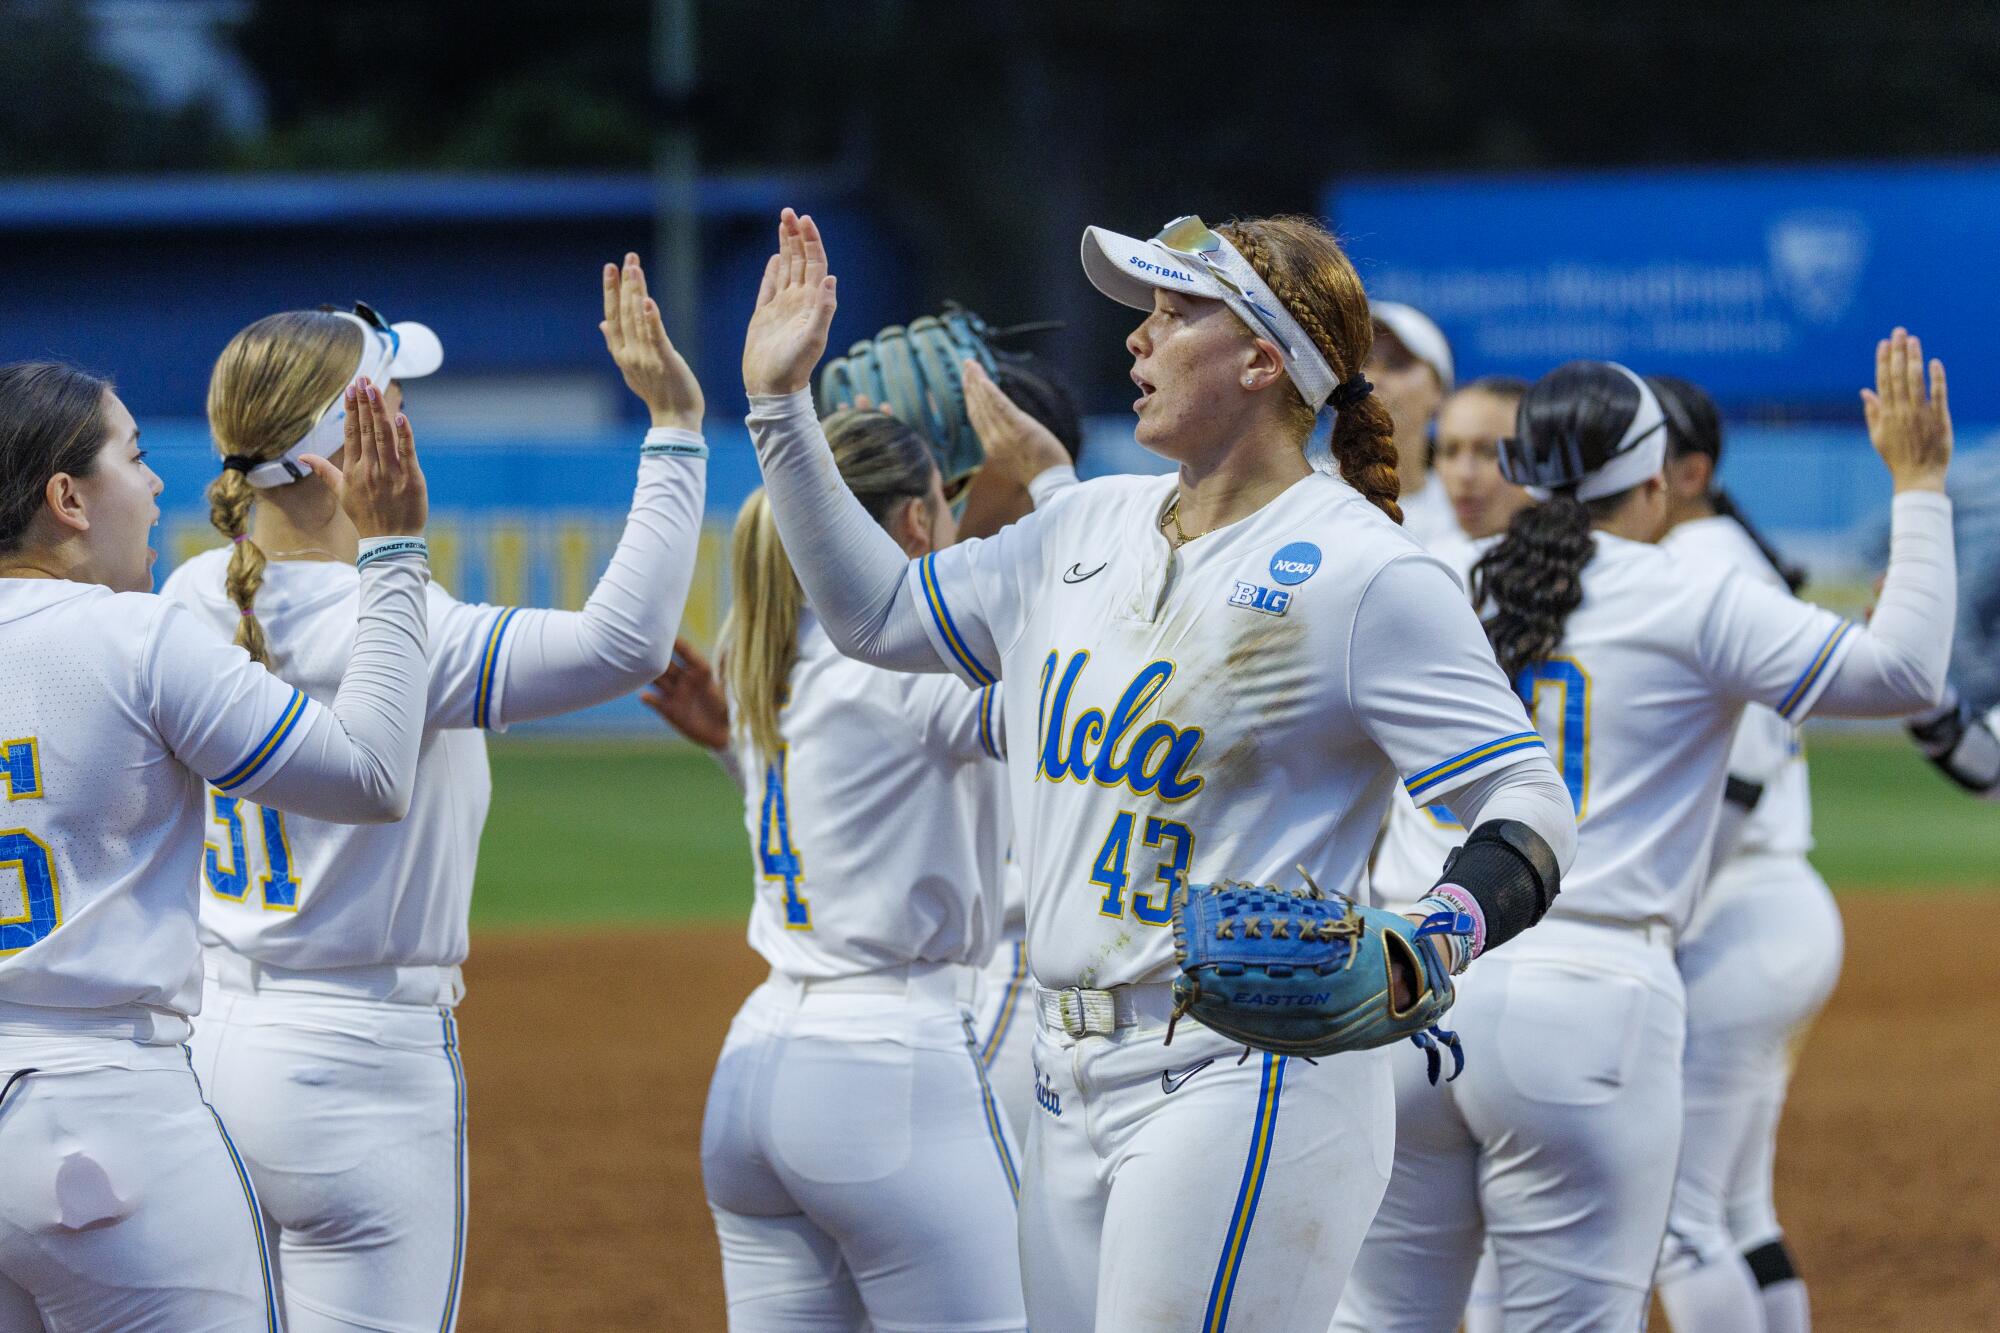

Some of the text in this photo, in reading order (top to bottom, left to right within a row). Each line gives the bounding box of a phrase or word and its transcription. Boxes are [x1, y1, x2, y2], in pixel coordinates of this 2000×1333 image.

[1130, 255, 1194, 283] SOFTBALL
[1274, 559, 1315, 575] NCAA
[202, 789, 302, 913] 31
[757, 740, 813, 931] 4
[1089, 810, 1195, 927] 43
[1232, 991, 1332, 1006] EASTON
